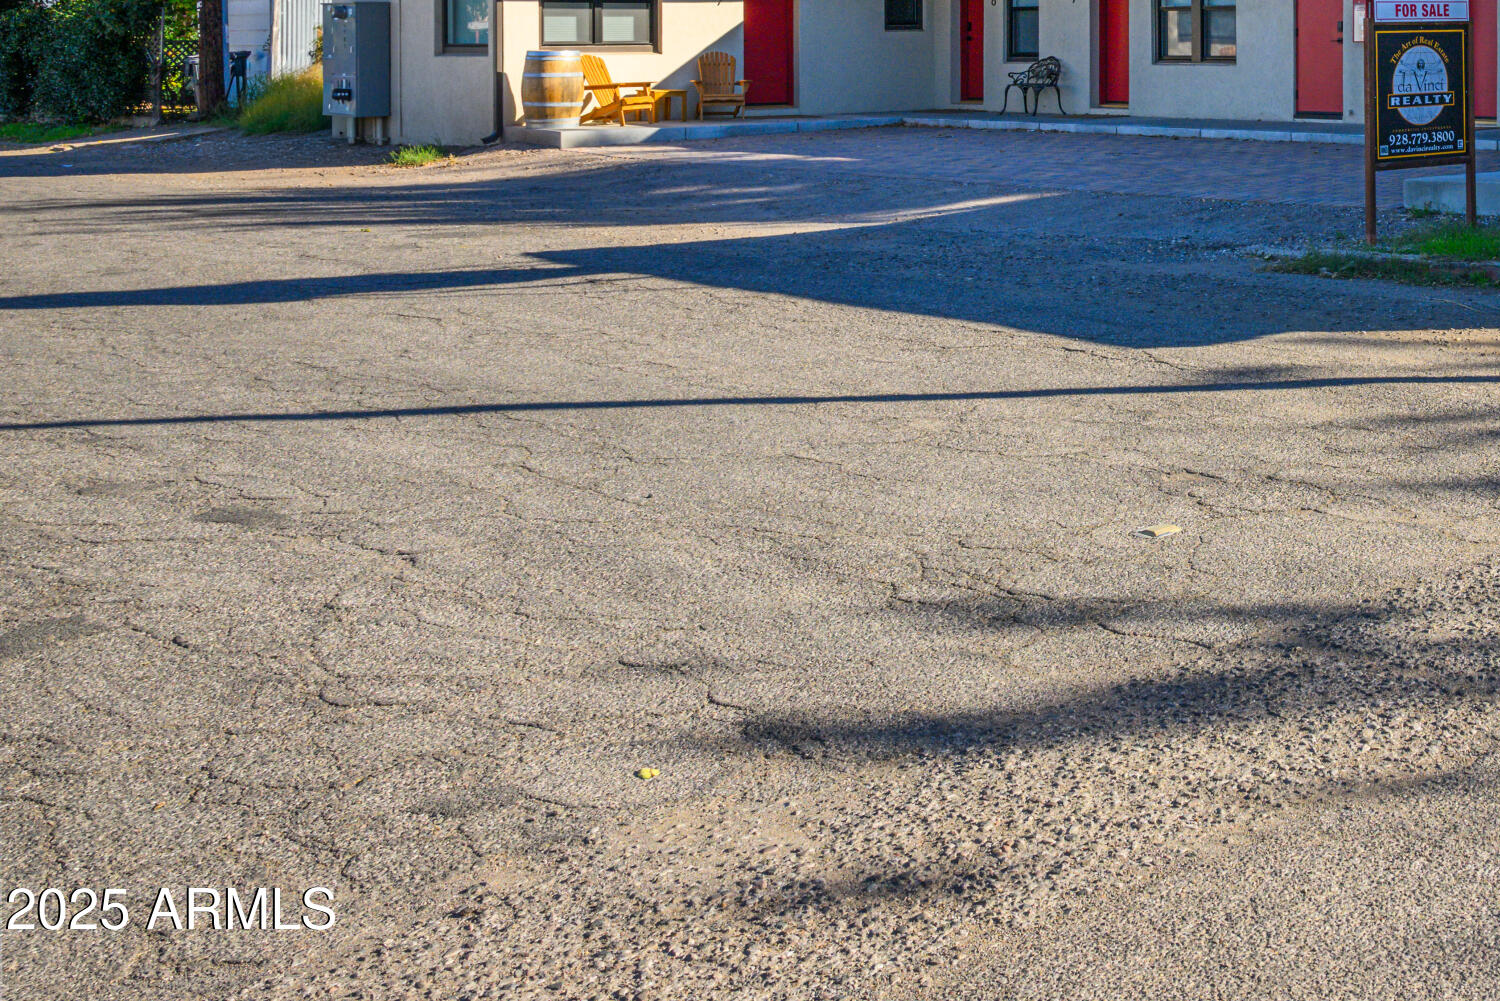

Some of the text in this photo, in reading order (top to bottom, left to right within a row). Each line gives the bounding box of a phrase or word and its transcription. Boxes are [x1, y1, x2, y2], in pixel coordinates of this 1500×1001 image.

[1395, 3, 1450, 17] FOR SALE
[1390, 50, 1401, 65] The
[1401, 40, 1412, 51] Art
[1419, 36, 1434, 47] Real
[1398, 70, 1444, 92] da Vinci
[1390, 93, 1452, 107] REALTY
[1389, 130, 1455, 146] 928.779.3800
